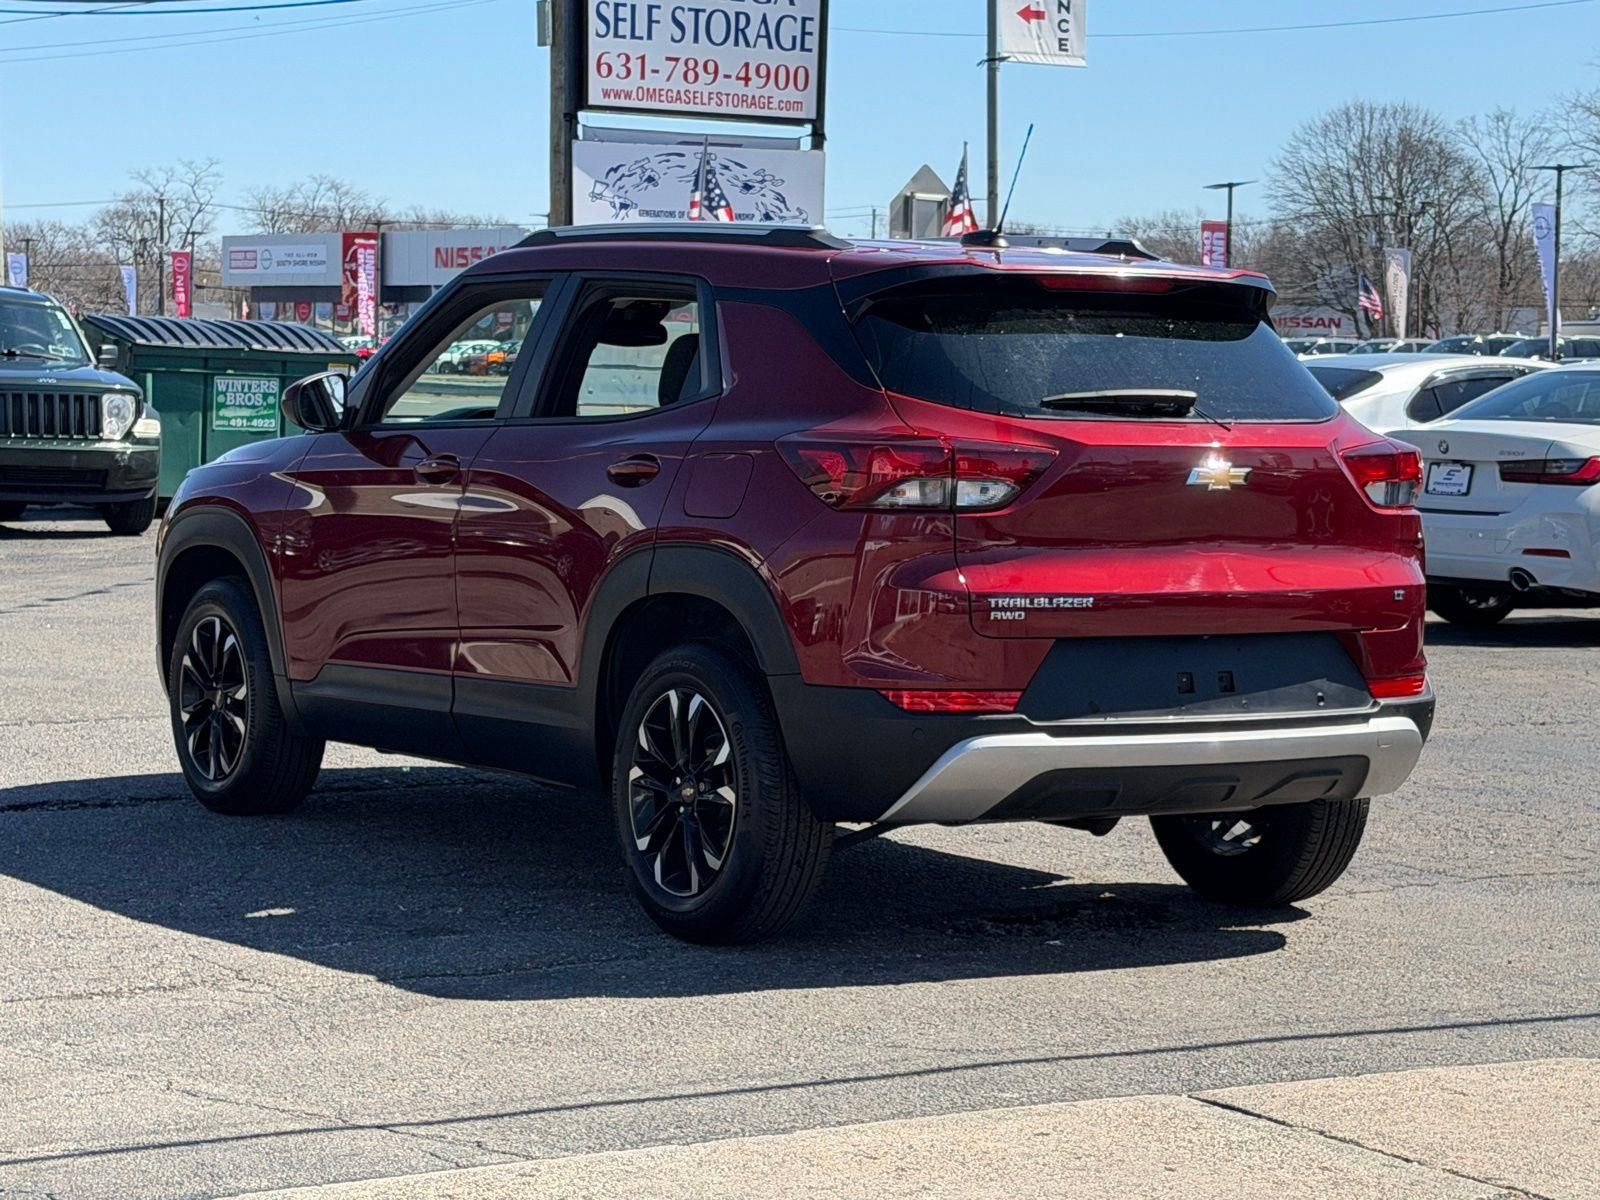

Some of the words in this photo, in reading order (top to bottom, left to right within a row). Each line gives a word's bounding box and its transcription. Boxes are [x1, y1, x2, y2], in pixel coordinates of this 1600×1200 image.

[595, 1, 661, 40] SELF
[670, 5, 814, 53] STORAGE
[595, 51, 810, 92] 631-789-4900
[434, 246, 507, 268] NISSA
[1273, 316, 1342, 329] NISSAN
[216, 380, 277, 393] WINTERS
[225, 393, 267, 406] BROS.
[988, 597, 1095, 608] TRAILBLAZER
[990, 611, 1026, 620] AWD
